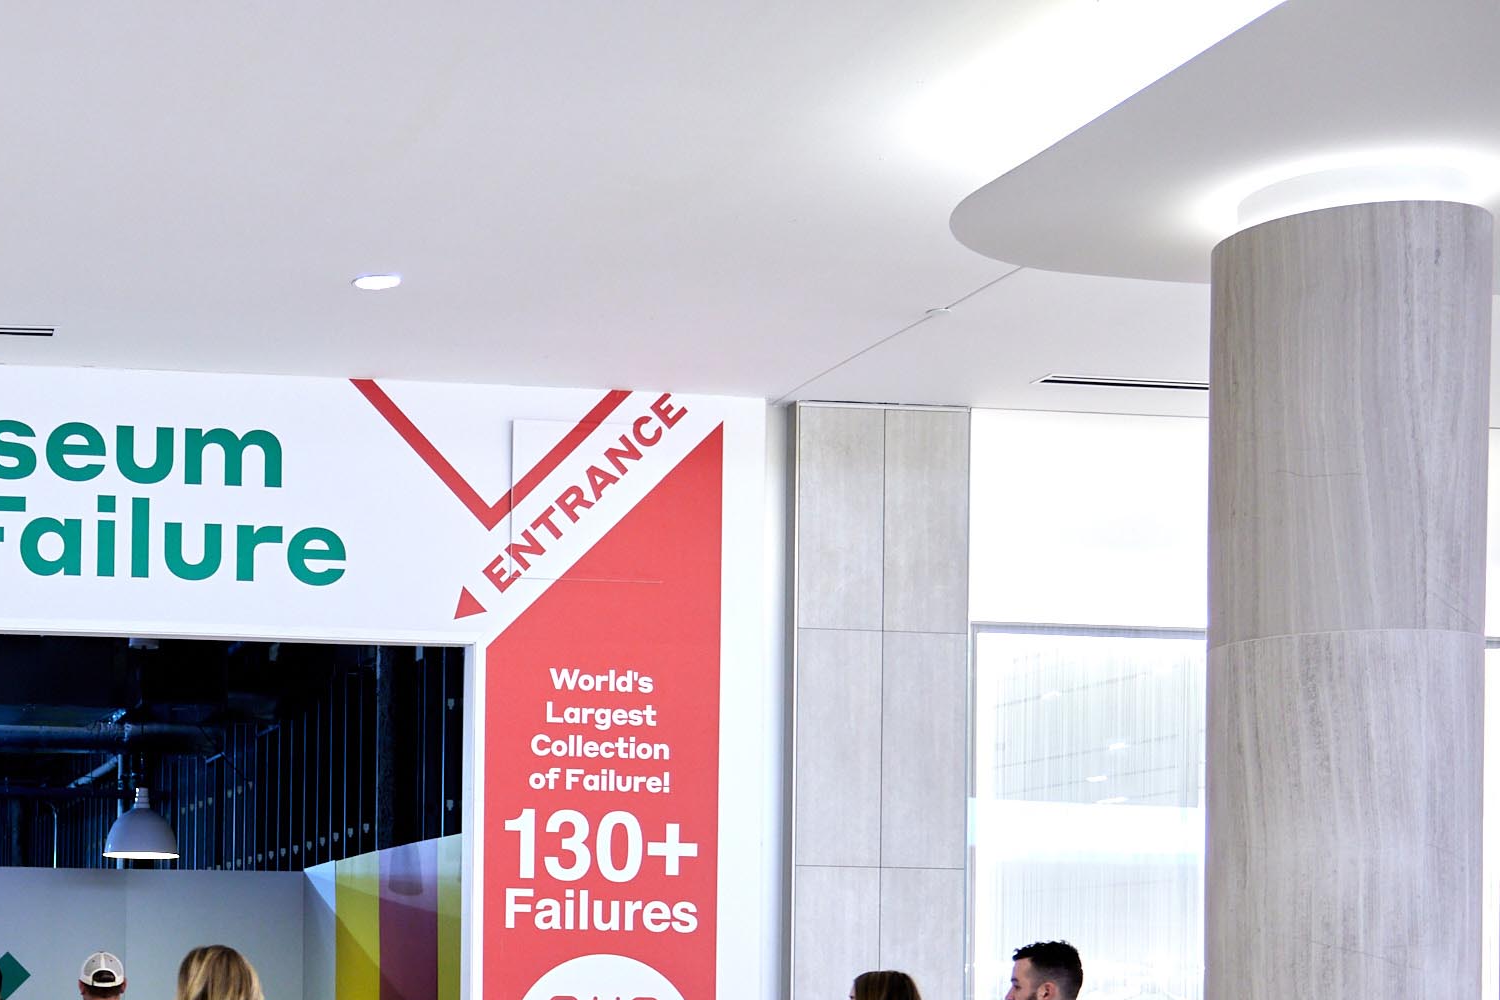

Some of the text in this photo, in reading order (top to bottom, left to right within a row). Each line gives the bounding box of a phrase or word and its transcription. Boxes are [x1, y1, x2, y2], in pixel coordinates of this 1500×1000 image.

[482, 393, 688, 593] ENTRANCE
[549, 668, 654, 694] World's
[546, 701, 657, 730] Largest
[530, 734, 670, 760] Collection
[528, 767, 670, 794] of Failure!
[504, 808, 699, 883] 130+
[504, 887, 699, 934] Failures
